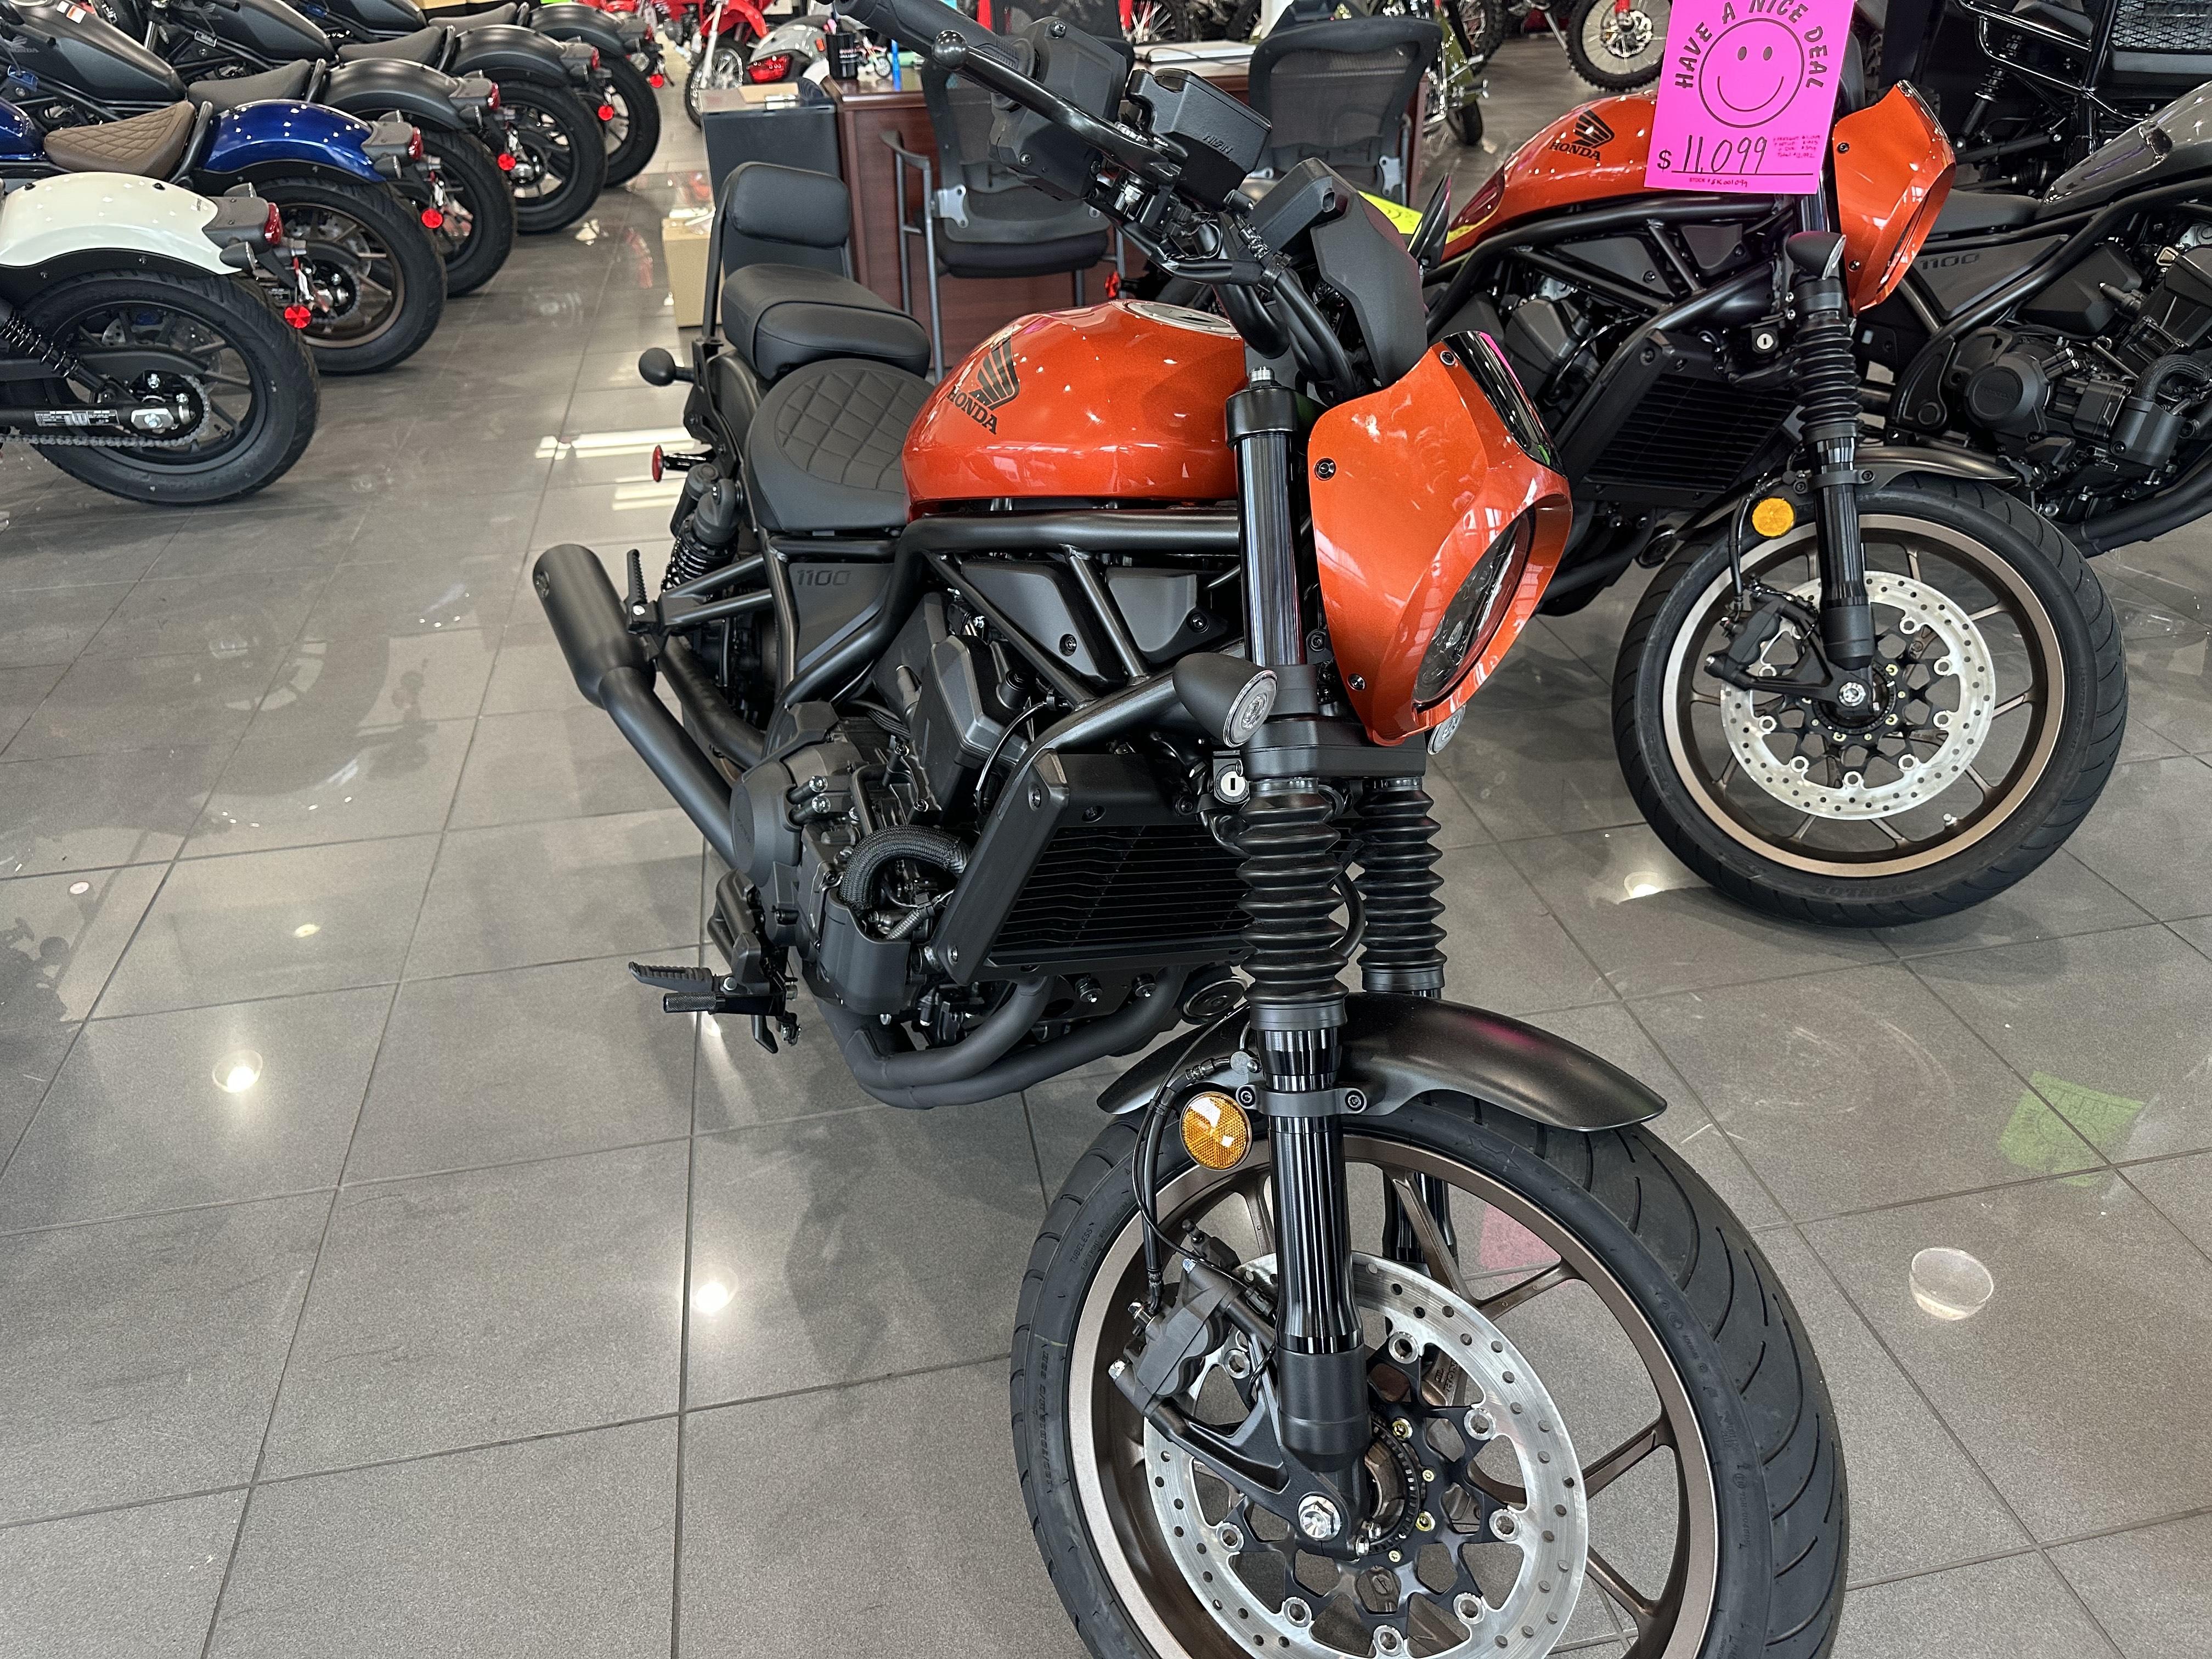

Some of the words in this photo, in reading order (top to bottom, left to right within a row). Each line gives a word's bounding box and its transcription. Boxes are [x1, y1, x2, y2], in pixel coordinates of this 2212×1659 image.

[1675, 22, 1713, 88] HAVE
[1722, 2, 1736, 24] A
[1748, 0, 1809, 24] NICE
[1804, 26, 1828, 88] DEAL
[1549, 142, 1601, 161] HONDA
[1920, 253, 1980, 270] 1100
[946, 385, 997, 435] HONDA
[797, 569, 851, 586] 1100
[1070, 1228, 1093, 1263] TUBELESS
[1087, 1239, 1101, 1258] FRONT
